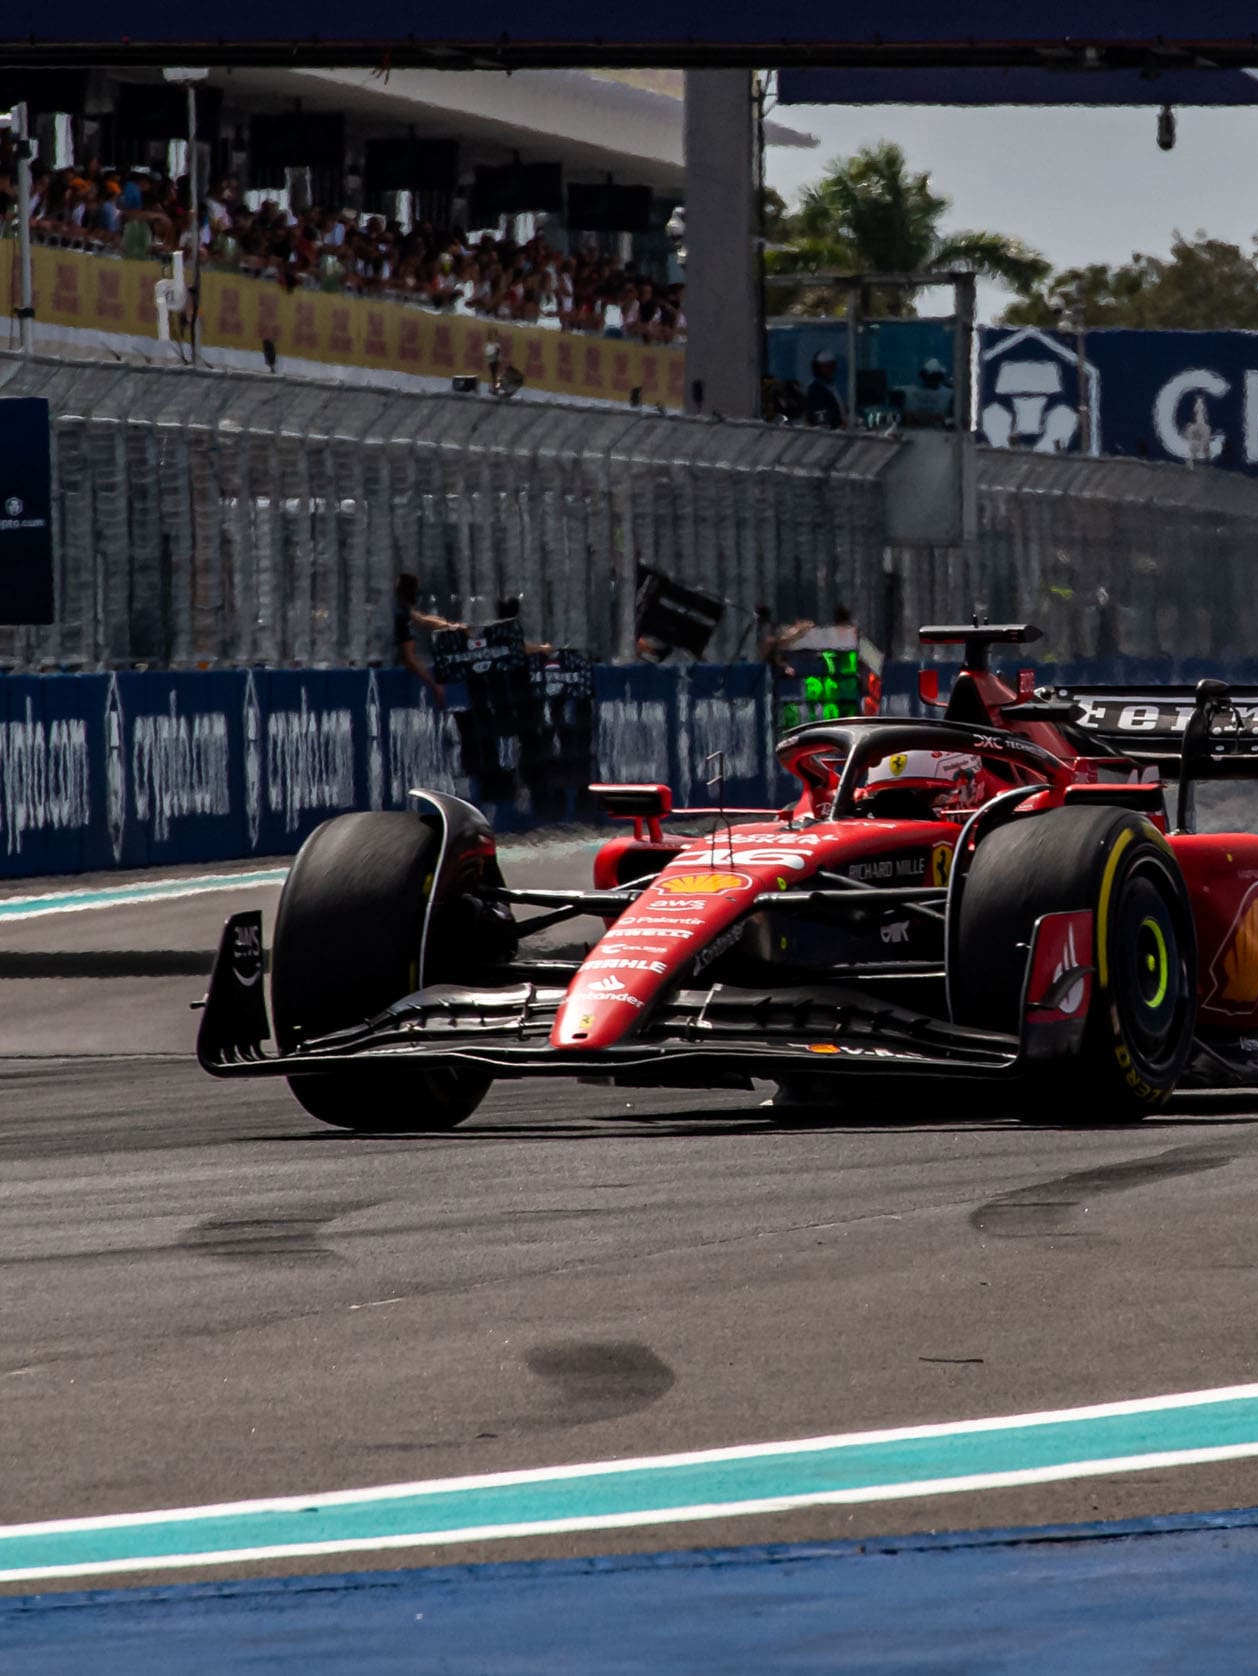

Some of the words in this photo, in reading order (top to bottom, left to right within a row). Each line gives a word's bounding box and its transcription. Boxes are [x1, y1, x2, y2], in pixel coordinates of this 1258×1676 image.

[667, 848, 813, 870] 16
[848, 860, 893, 880] RICHARD
[896, 857, 926, 874] MILLE
[578, 958, 667, 975] MAHLE
